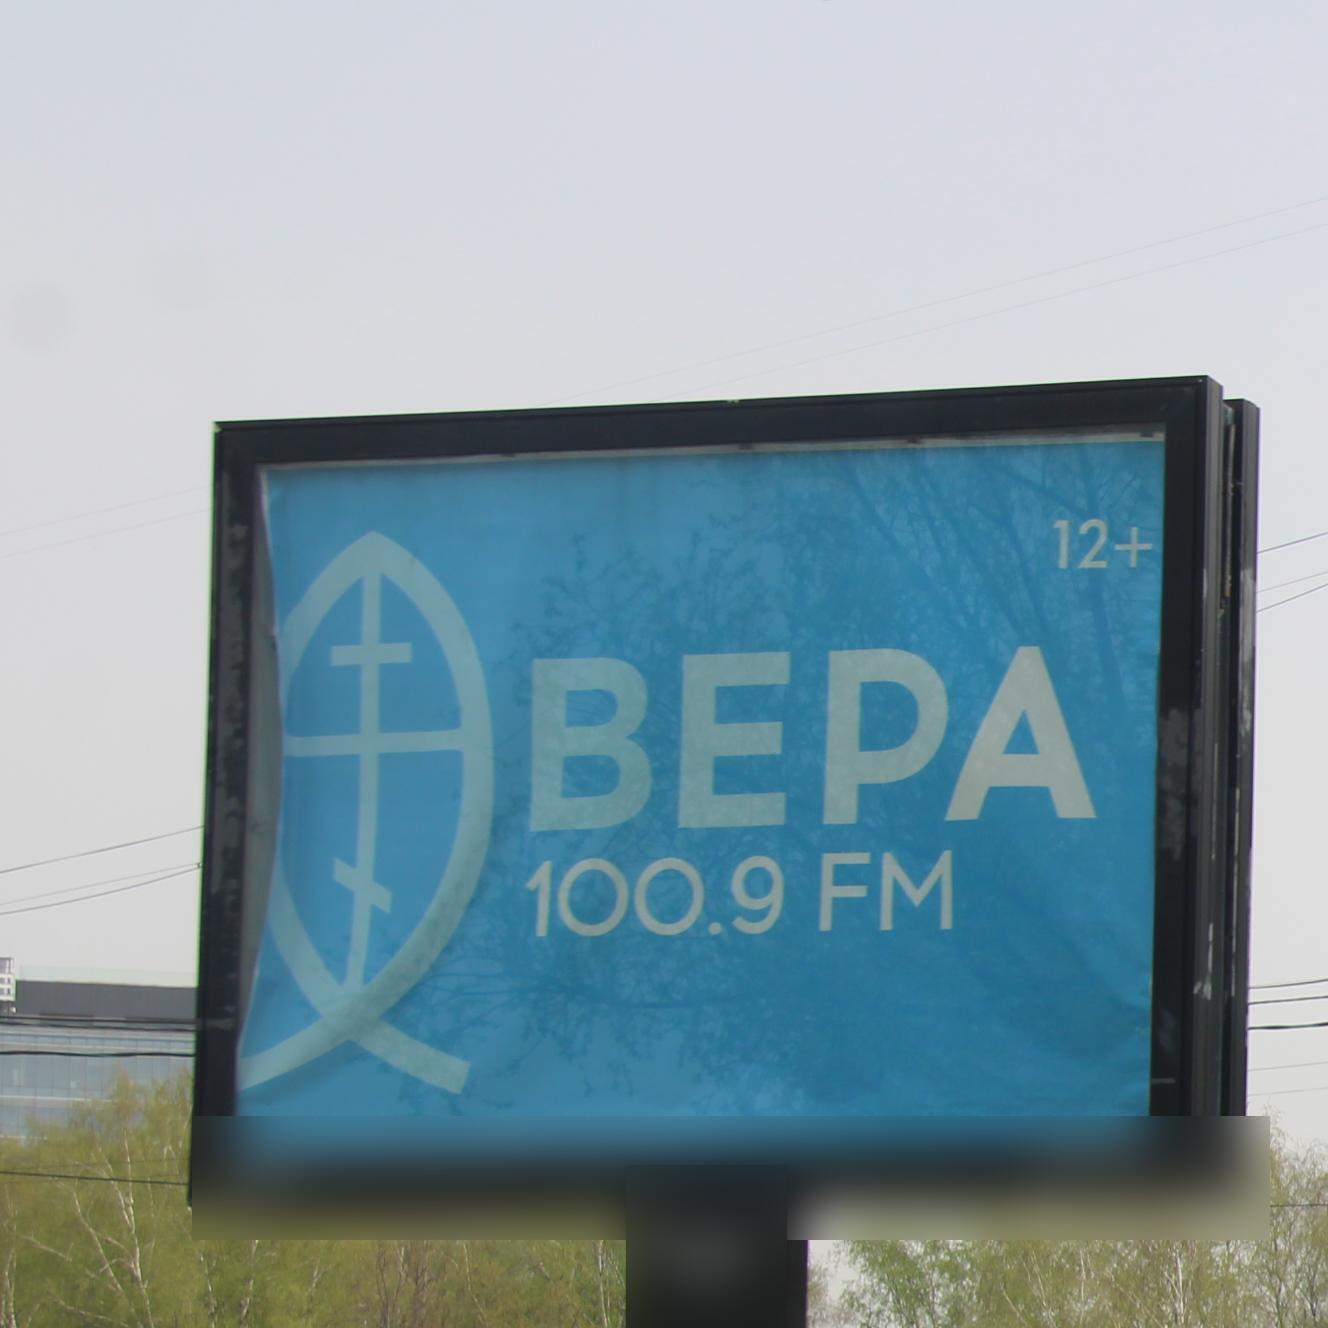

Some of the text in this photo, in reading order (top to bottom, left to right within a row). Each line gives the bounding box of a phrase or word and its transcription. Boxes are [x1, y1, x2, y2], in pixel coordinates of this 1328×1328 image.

[1052, 518, 1153, 569] 12+
[529, 646, 1097, 832] ВЕРА
[526, 849, 953, 937] 100.9 FM
